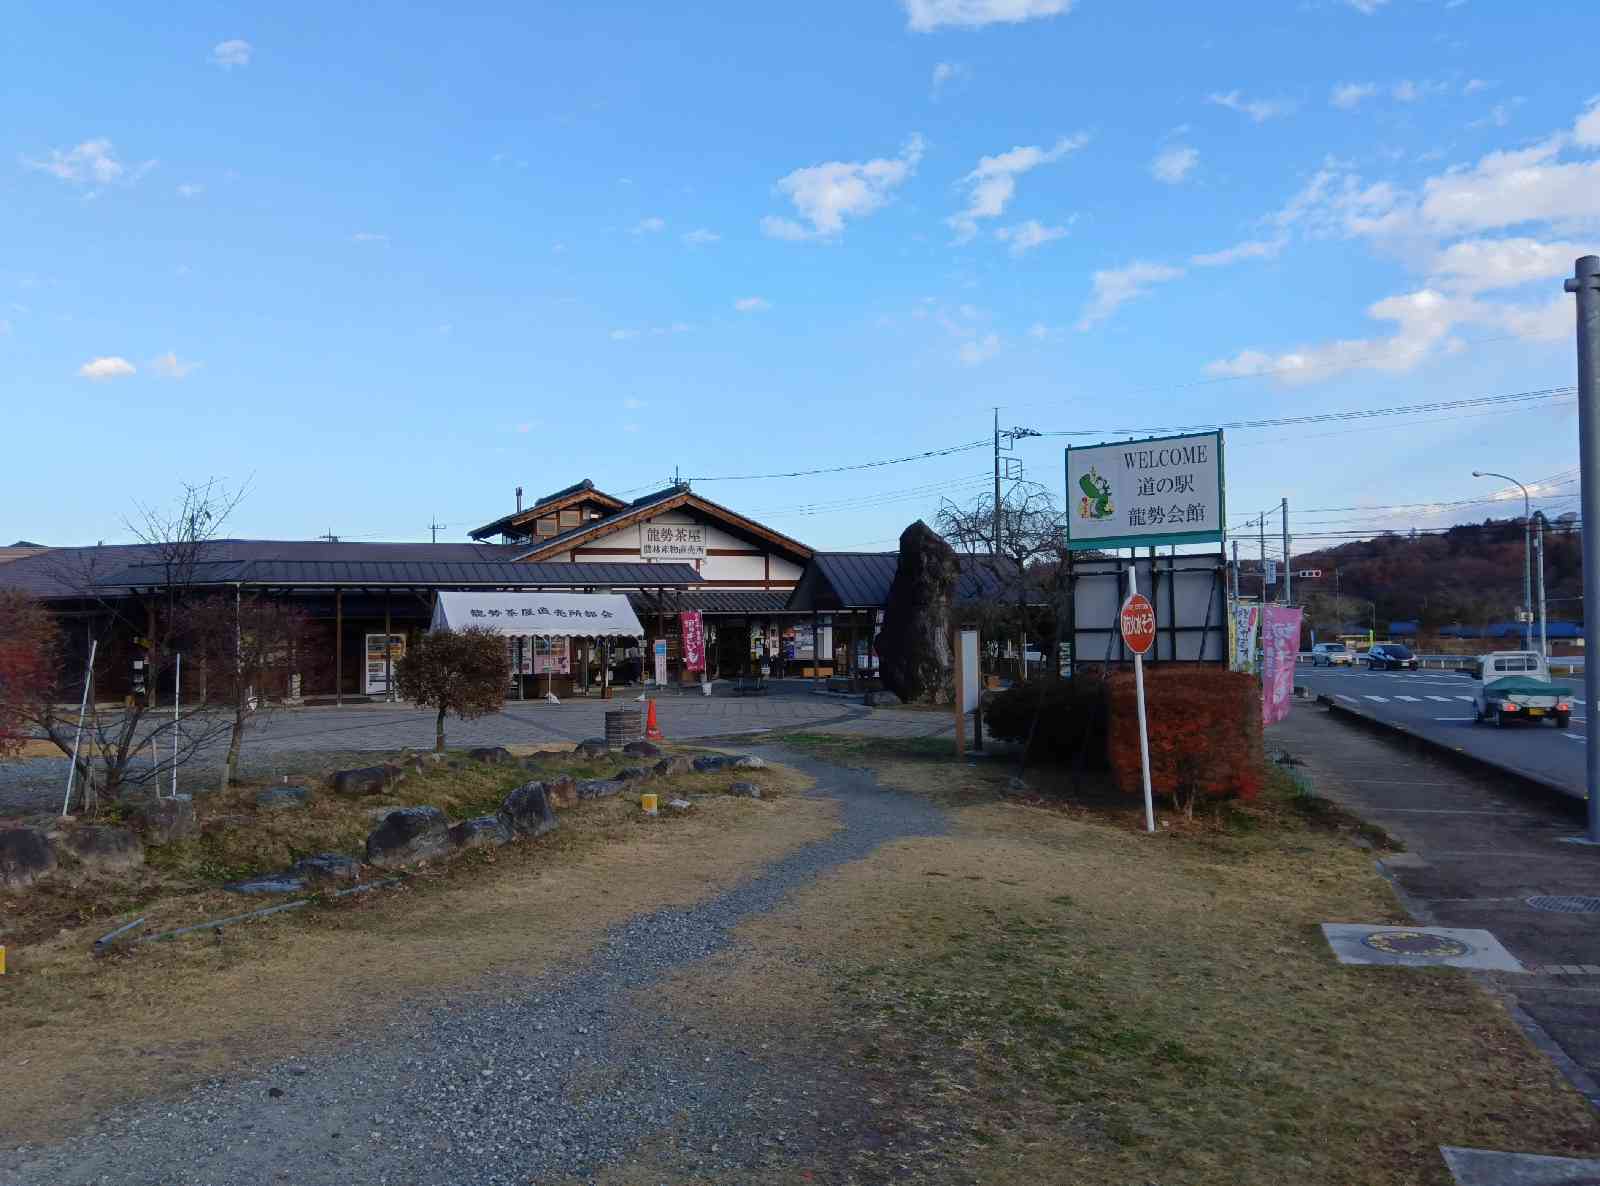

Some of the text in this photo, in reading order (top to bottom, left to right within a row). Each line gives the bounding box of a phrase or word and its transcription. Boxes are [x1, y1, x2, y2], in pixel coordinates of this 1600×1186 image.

[1124, 445, 1208, 470] WELCOME
[1137, 475, 1194, 497] 道の駅
[1128, 502, 1206, 527] 龍勢会館
[647, 528, 702, 542] 龍勢茶屋
